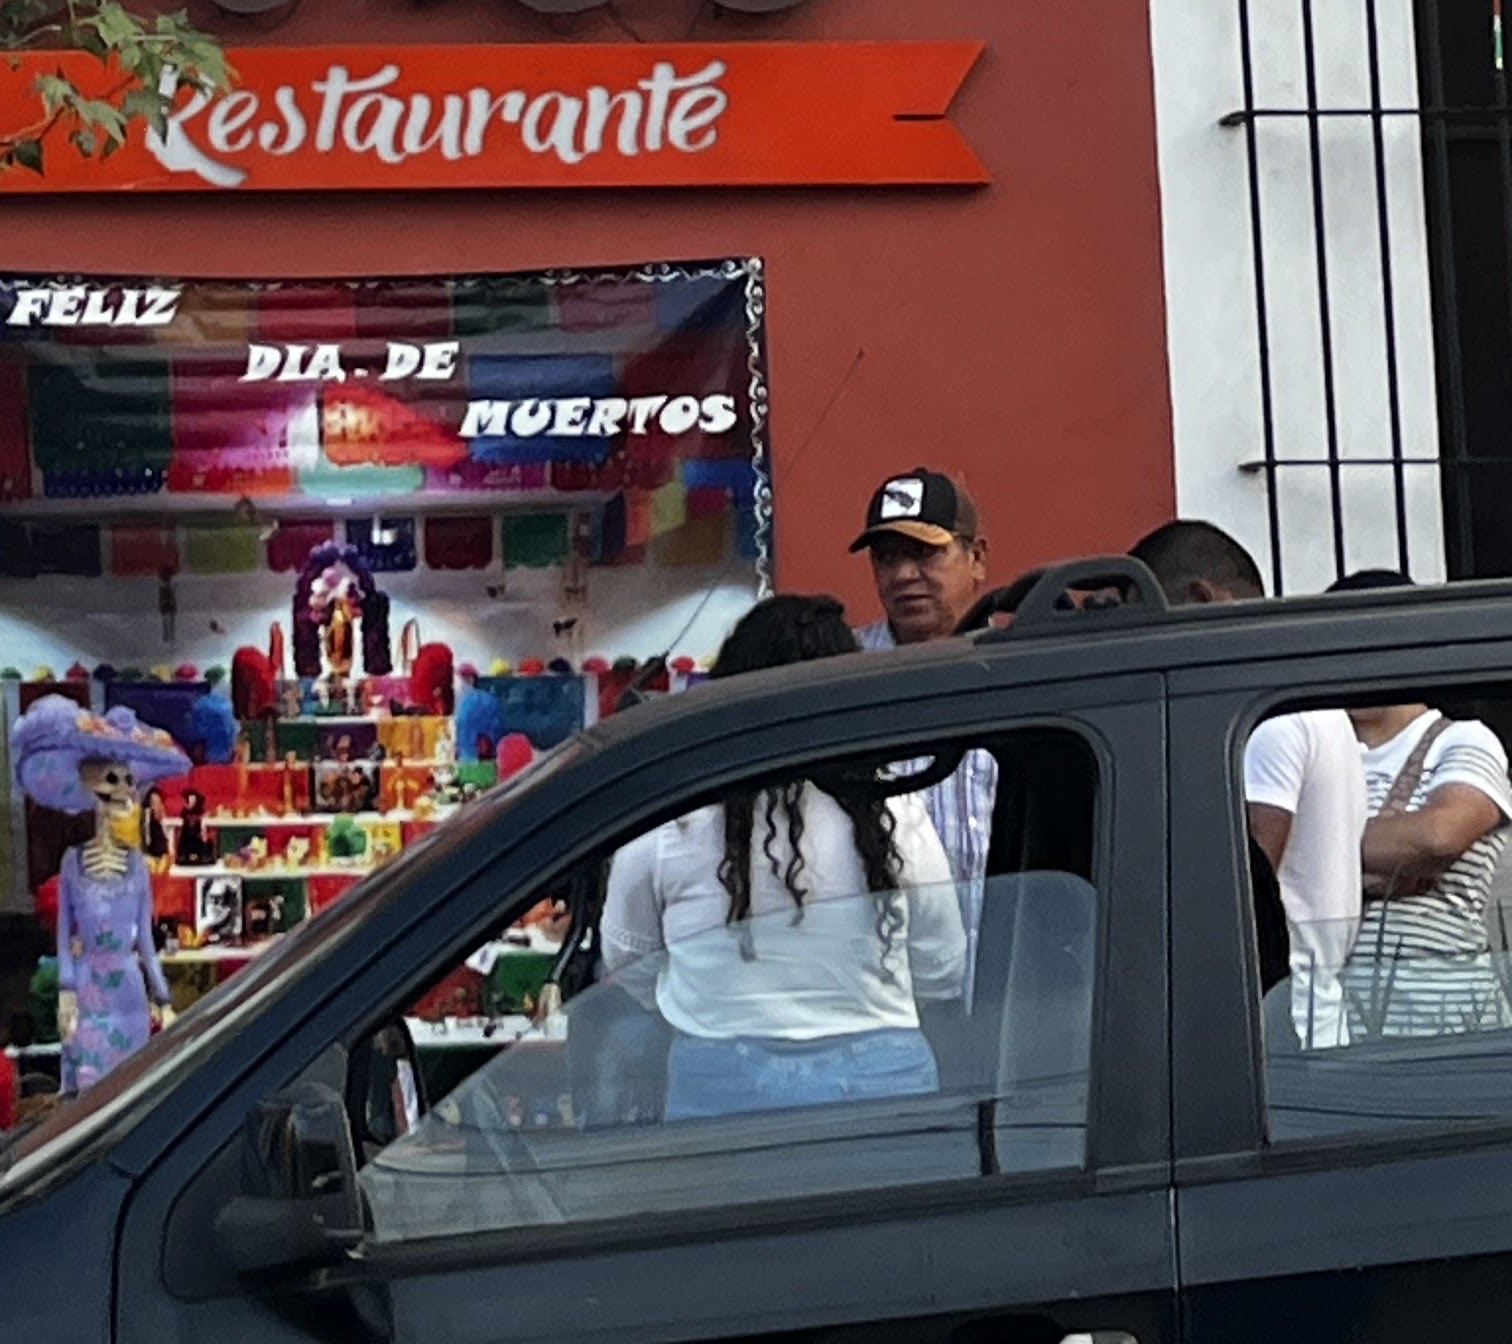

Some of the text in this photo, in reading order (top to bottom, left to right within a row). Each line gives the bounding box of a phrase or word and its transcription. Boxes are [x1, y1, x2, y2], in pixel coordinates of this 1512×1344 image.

[145, 60, 727, 188] Restaurante
[5, 287, 181, 326] FELIZ
[379, 340, 460, 380] DE
[458, 394, 738, 439] MUERTOS
